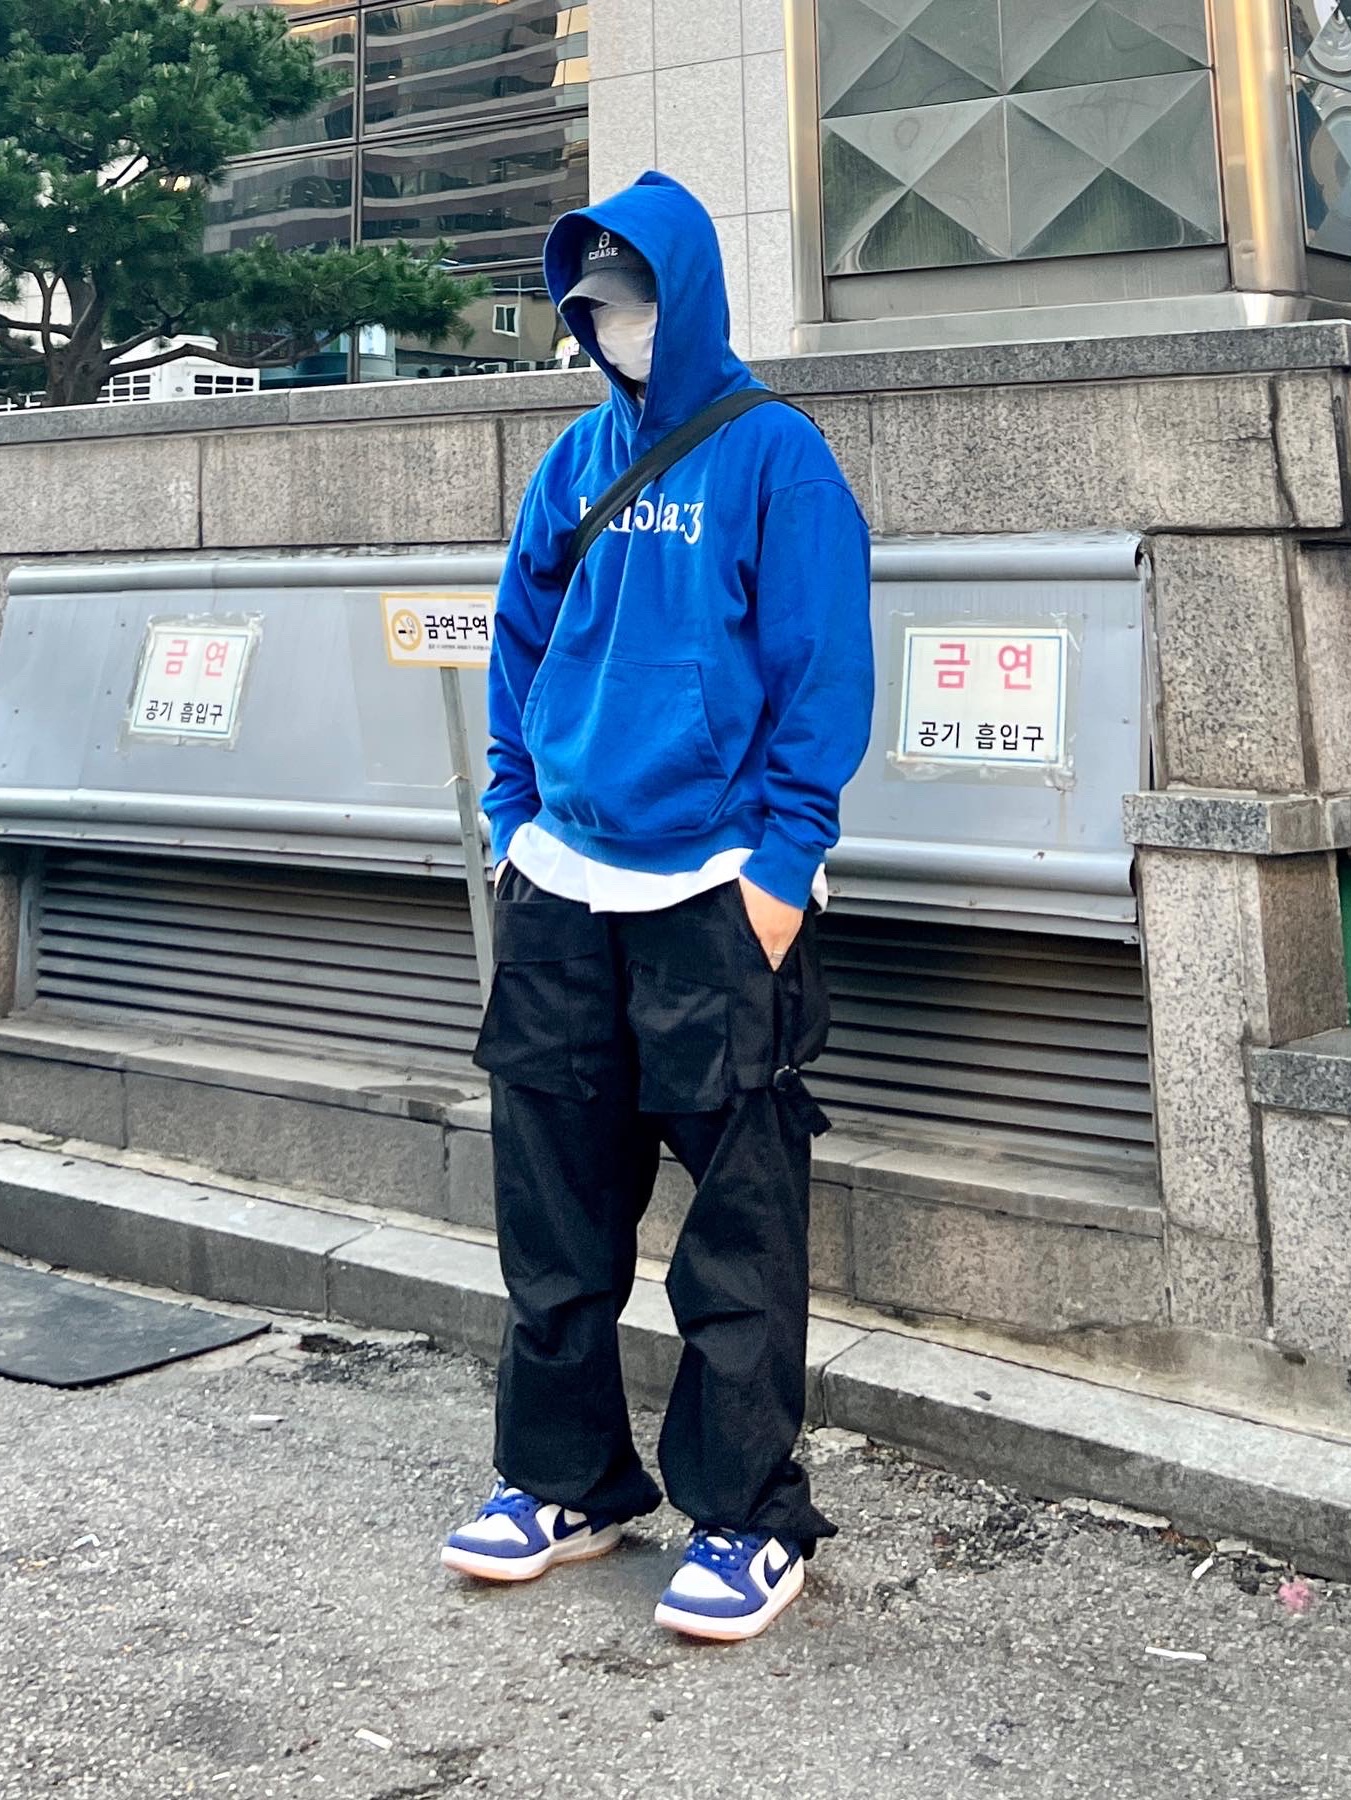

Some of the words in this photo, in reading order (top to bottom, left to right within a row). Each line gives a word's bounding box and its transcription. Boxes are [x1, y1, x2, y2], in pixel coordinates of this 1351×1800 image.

[588, 247, 619, 261] CHASE
[424, 614, 489, 641] 금연구역
[145, 700, 174, 721] 공기
[180, 702, 223, 726] 흡입구
[918, 721, 961, 749] 공기
[975, 722, 1045, 752] 흡입구
